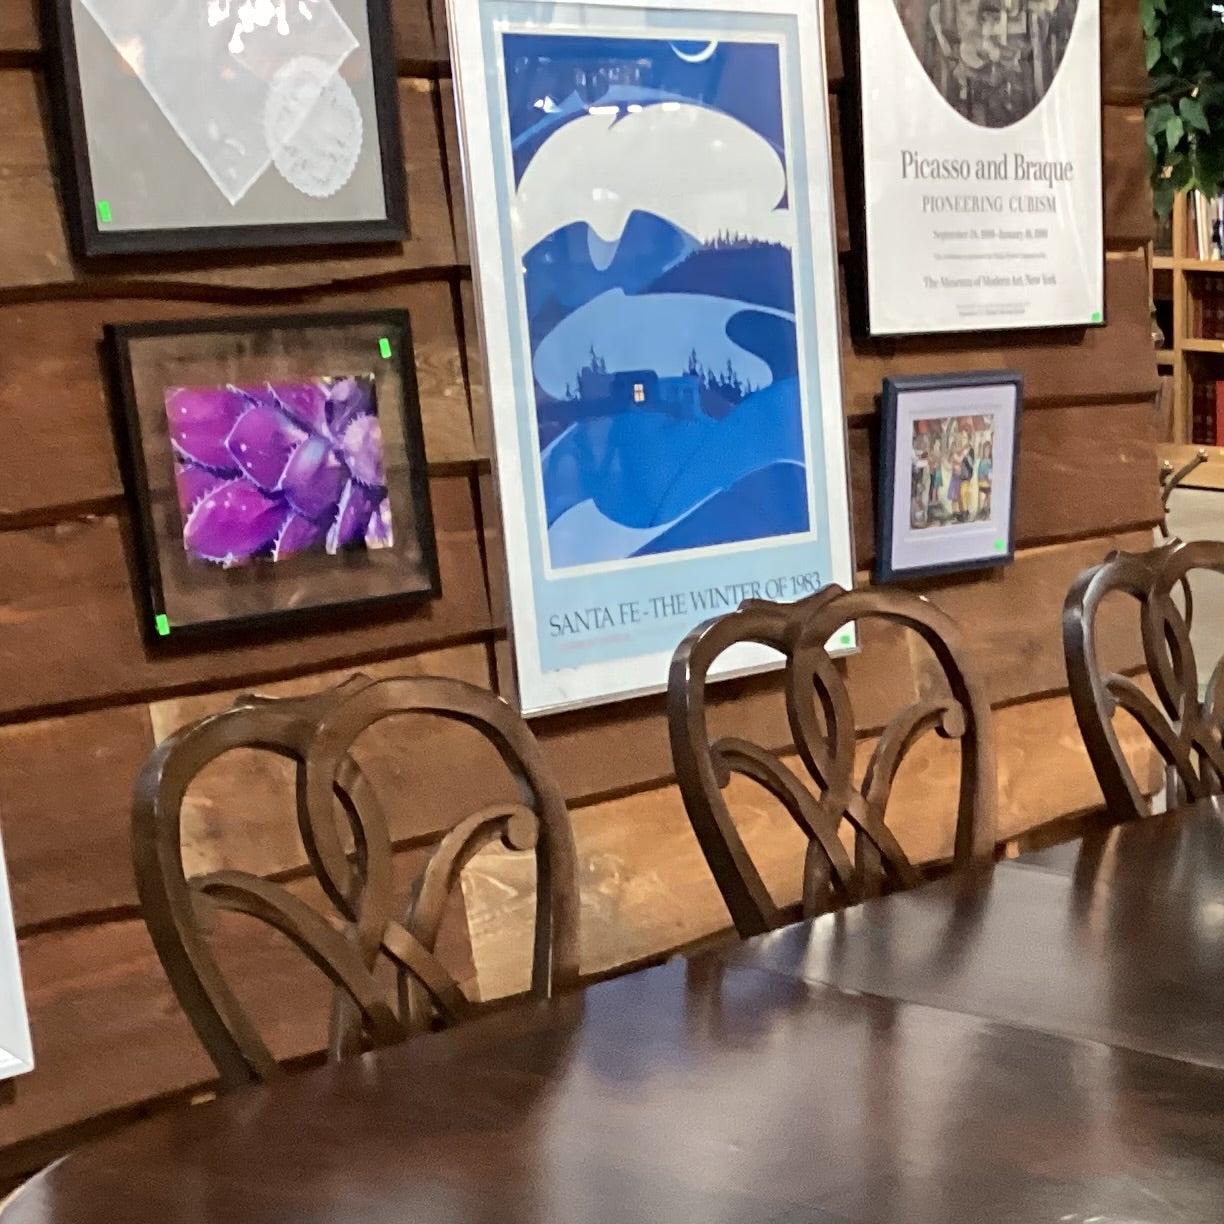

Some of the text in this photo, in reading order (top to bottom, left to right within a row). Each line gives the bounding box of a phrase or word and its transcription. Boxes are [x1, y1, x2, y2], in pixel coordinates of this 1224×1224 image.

[901, 150, 1074, 189] Picasso and Braque
[922, 194, 1056, 213] PIONEERING CUBISM
[549, 607, 615, 637] SANTA
[618, 602, 640, 625] FE
[650, 592, 687, 618] THE
[690, 580, 762, 611] WINTER
[765, 576, 788, 599] OF
[791, 571, 822, 596] 1983
